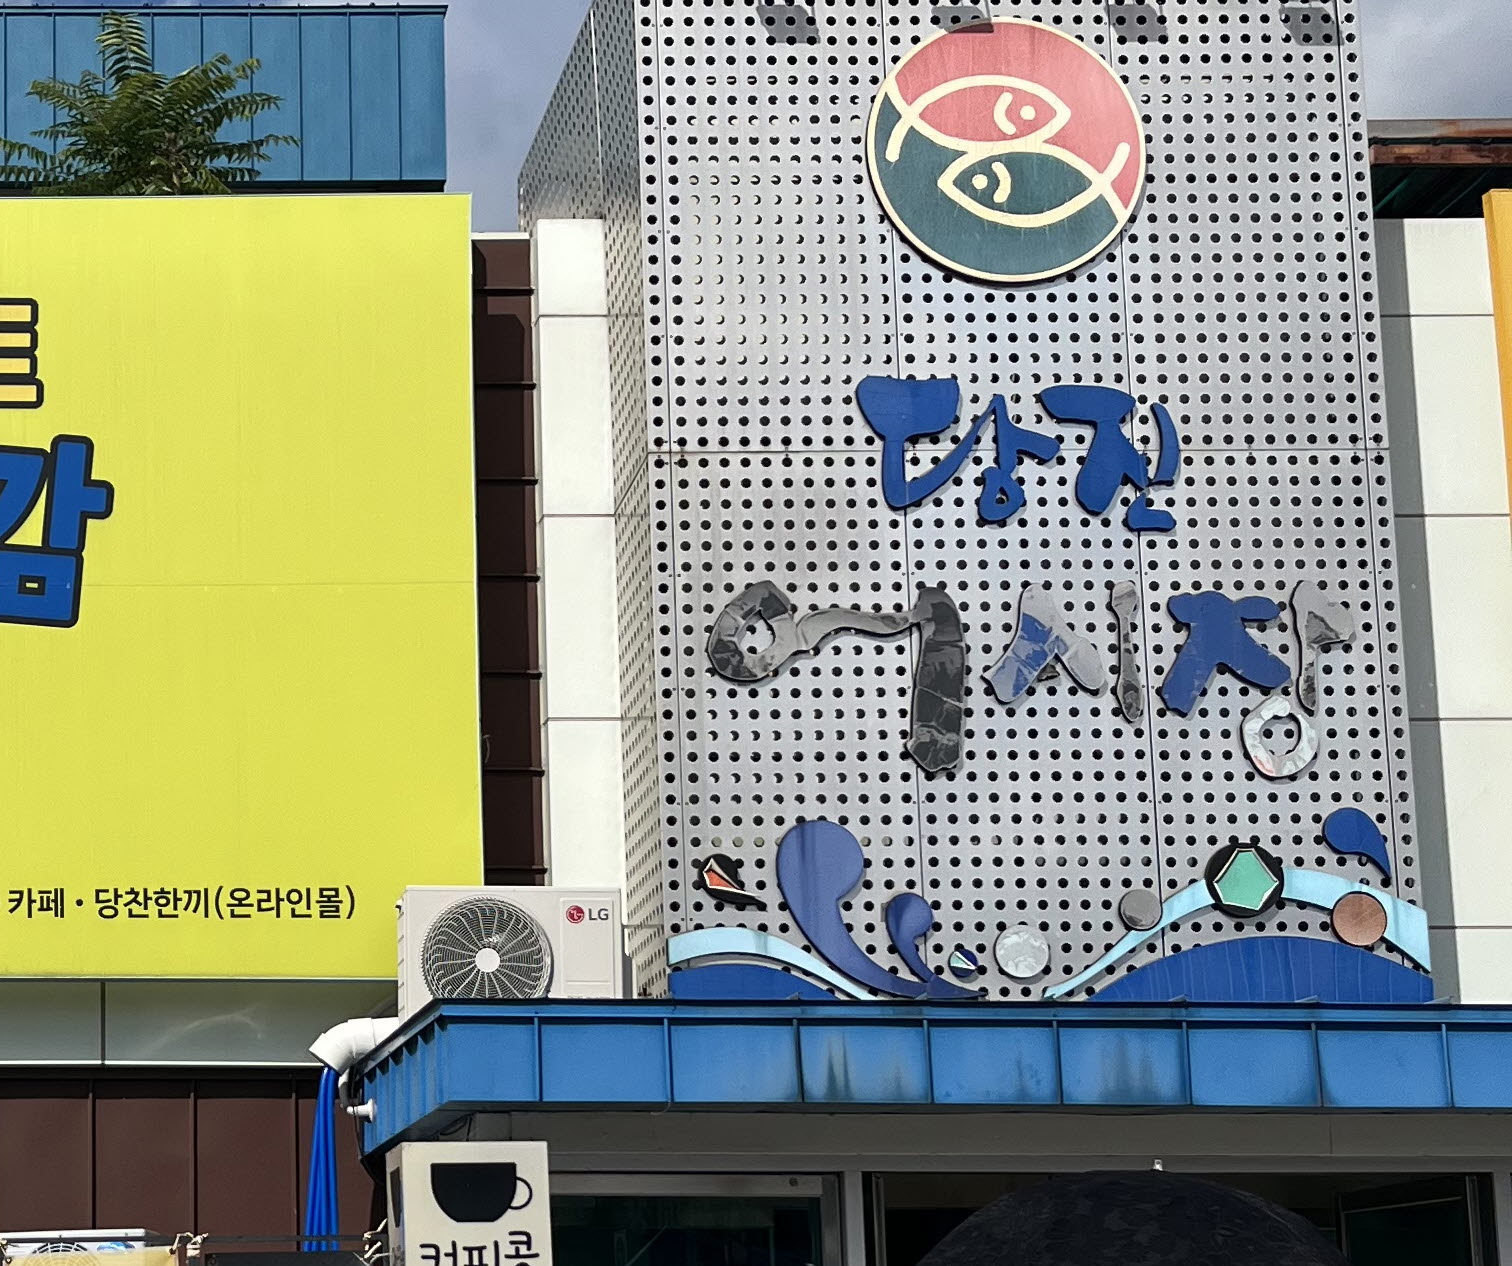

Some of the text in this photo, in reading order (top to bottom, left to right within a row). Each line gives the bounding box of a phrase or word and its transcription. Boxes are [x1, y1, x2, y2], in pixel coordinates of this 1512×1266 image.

[856, 375, 1181, 532] 당진
[708, 580, 1357, 781] 어시장
[7, 887, 65, 919] 카페
[93, 886, 356, 920] 당찬한끼(온라인몰)
[588, 907, 609, 921] LG
